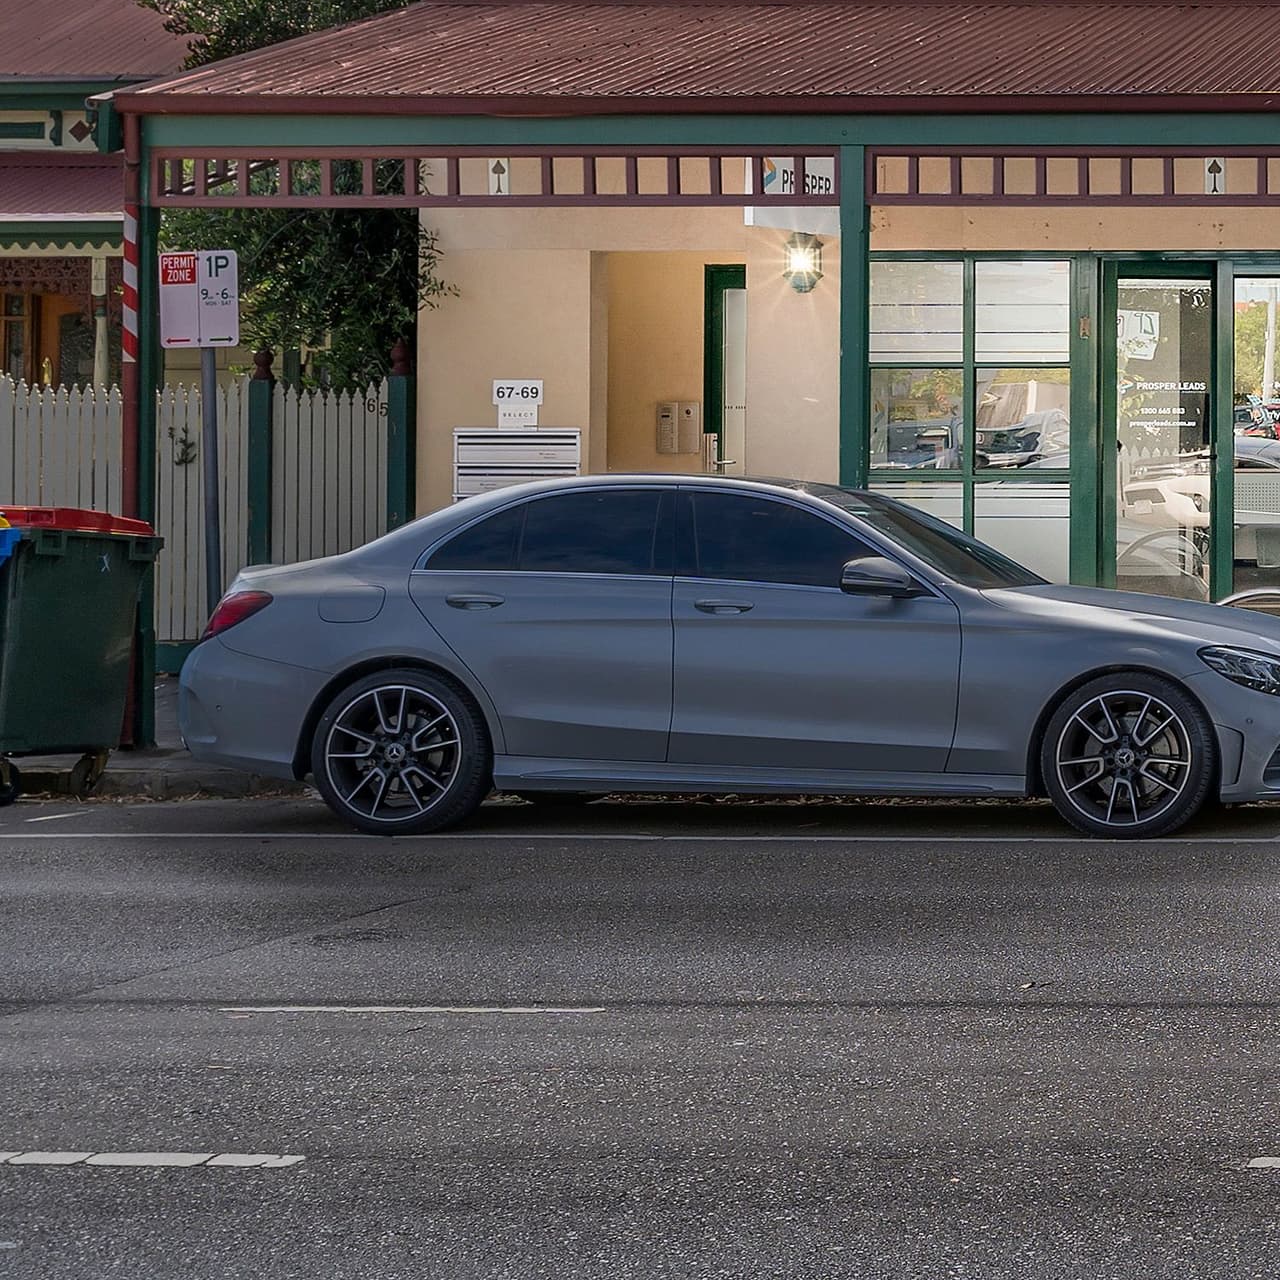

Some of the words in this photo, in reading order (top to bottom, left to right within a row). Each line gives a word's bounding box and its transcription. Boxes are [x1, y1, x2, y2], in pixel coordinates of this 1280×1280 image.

[782, 169, 831, 194] PRSPER
[162, 256, 195, 269] PERMIT
[206, 255, 229, 277] 1P
[167, 269, 191, 281] ZONE
[496, 386, 539, 399] 67-69
[1137, 382, 1175, 390] PROSPER
[1179, 382, 1206, 390] LEADS
